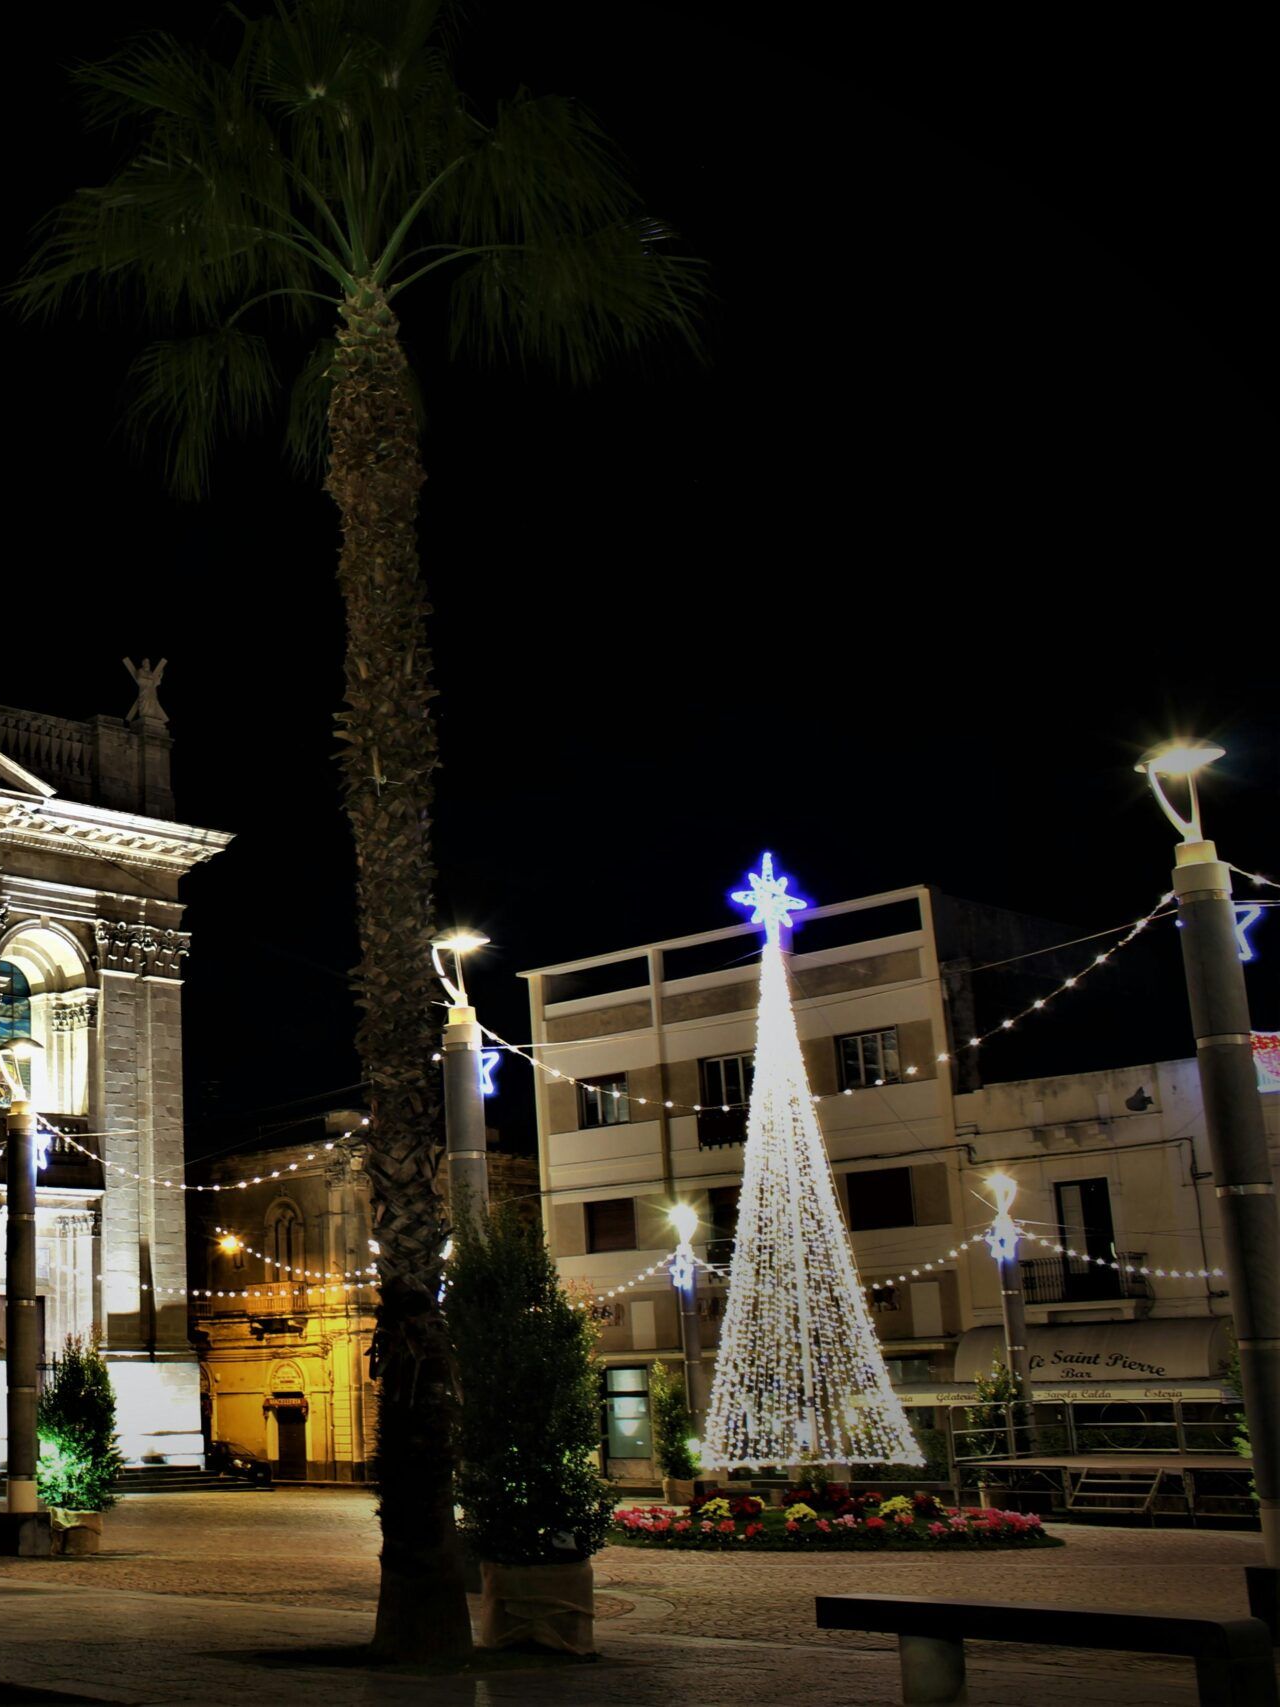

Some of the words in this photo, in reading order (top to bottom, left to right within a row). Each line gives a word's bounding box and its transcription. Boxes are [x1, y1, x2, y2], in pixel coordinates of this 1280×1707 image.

[1051, 1349, 1101, 1365] Saint
[1105, 1352, 1167, 1377] Pierre
[1060, 1367, 1093, 1379] Bar
[1080, 1388, 1112, 1398] Calda
[1144, 1387, 1183, 1398] Osteria
